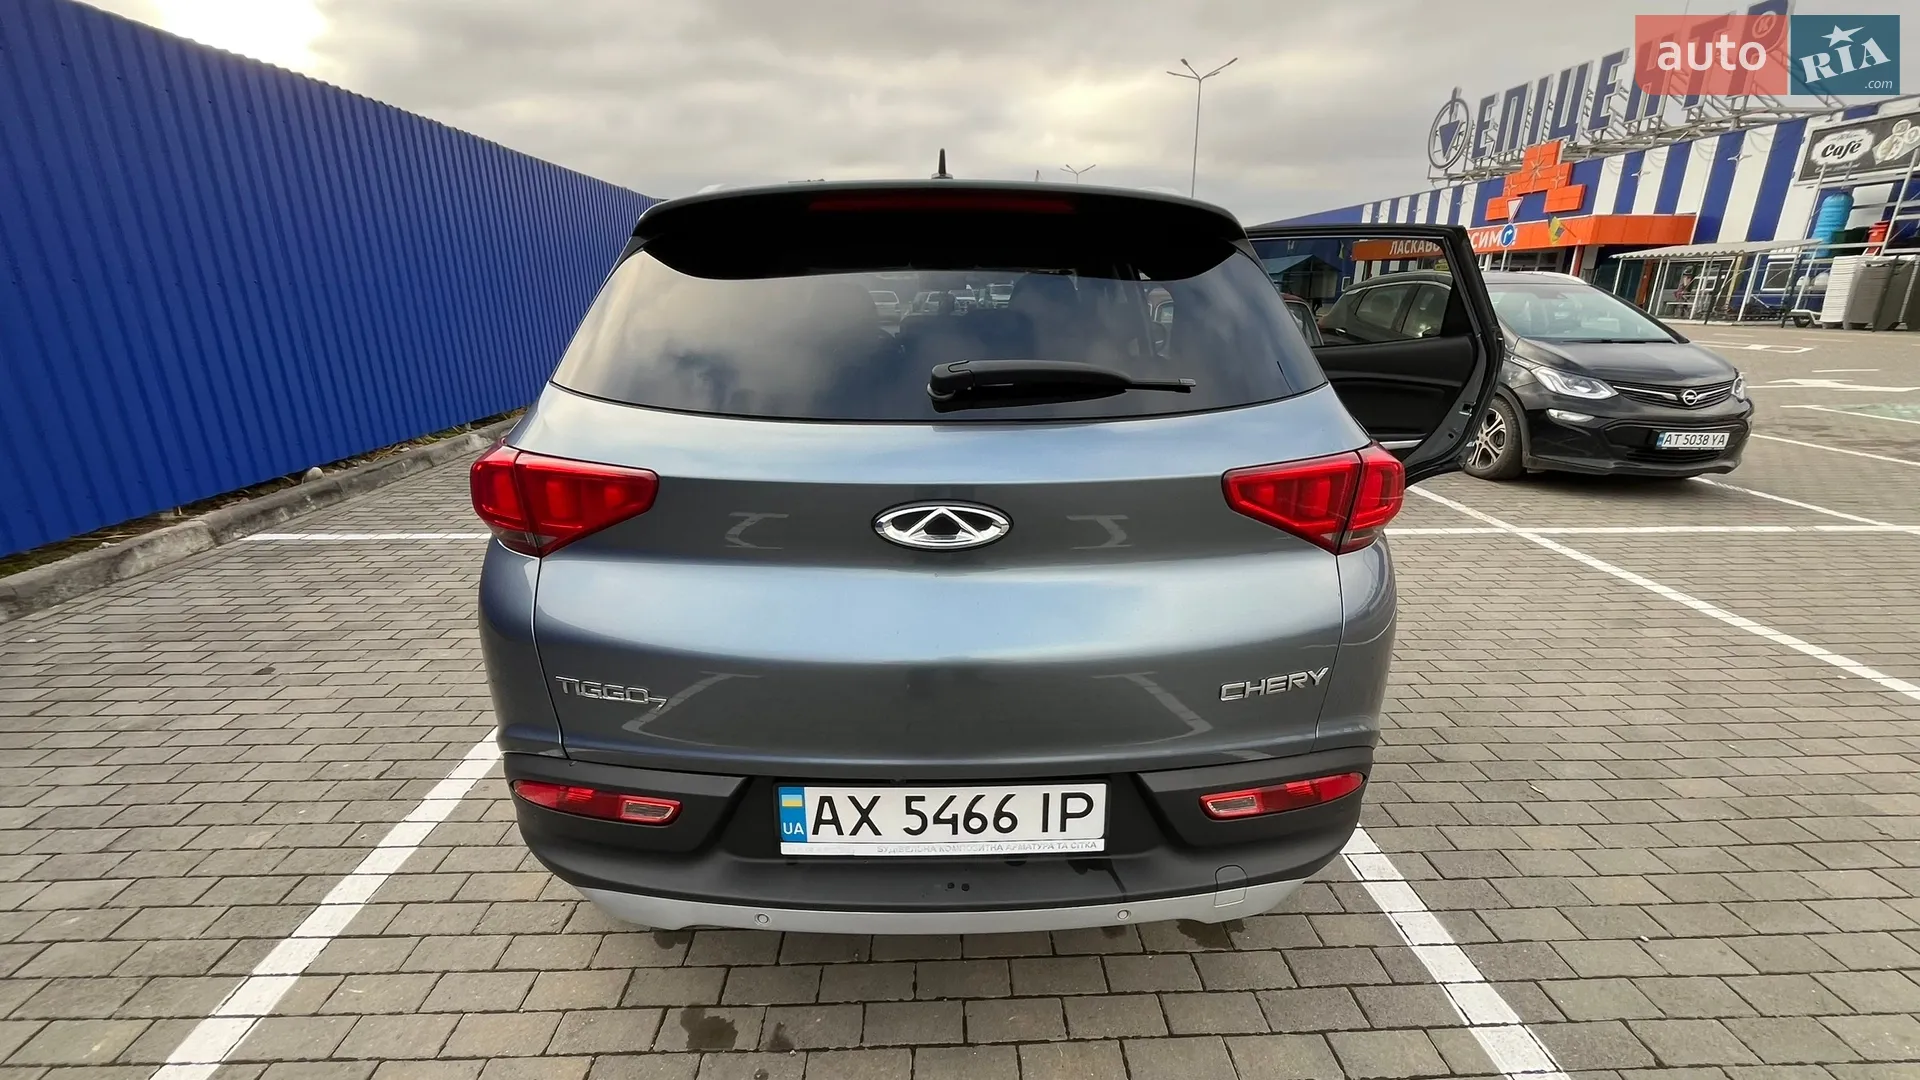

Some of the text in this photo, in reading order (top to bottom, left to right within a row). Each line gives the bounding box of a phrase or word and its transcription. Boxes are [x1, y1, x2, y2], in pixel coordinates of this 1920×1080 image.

[1821, 138, 1864, 160] Café
[1663, 433, 1726, 446] AT 5038 YA
[555, 675, 649, 705] TIGGO
[1219, 666, 1329, 702] CHERY
[811, 791, 1095, 837] AX 5466 IP
[783, 822, 805, 836] UA
